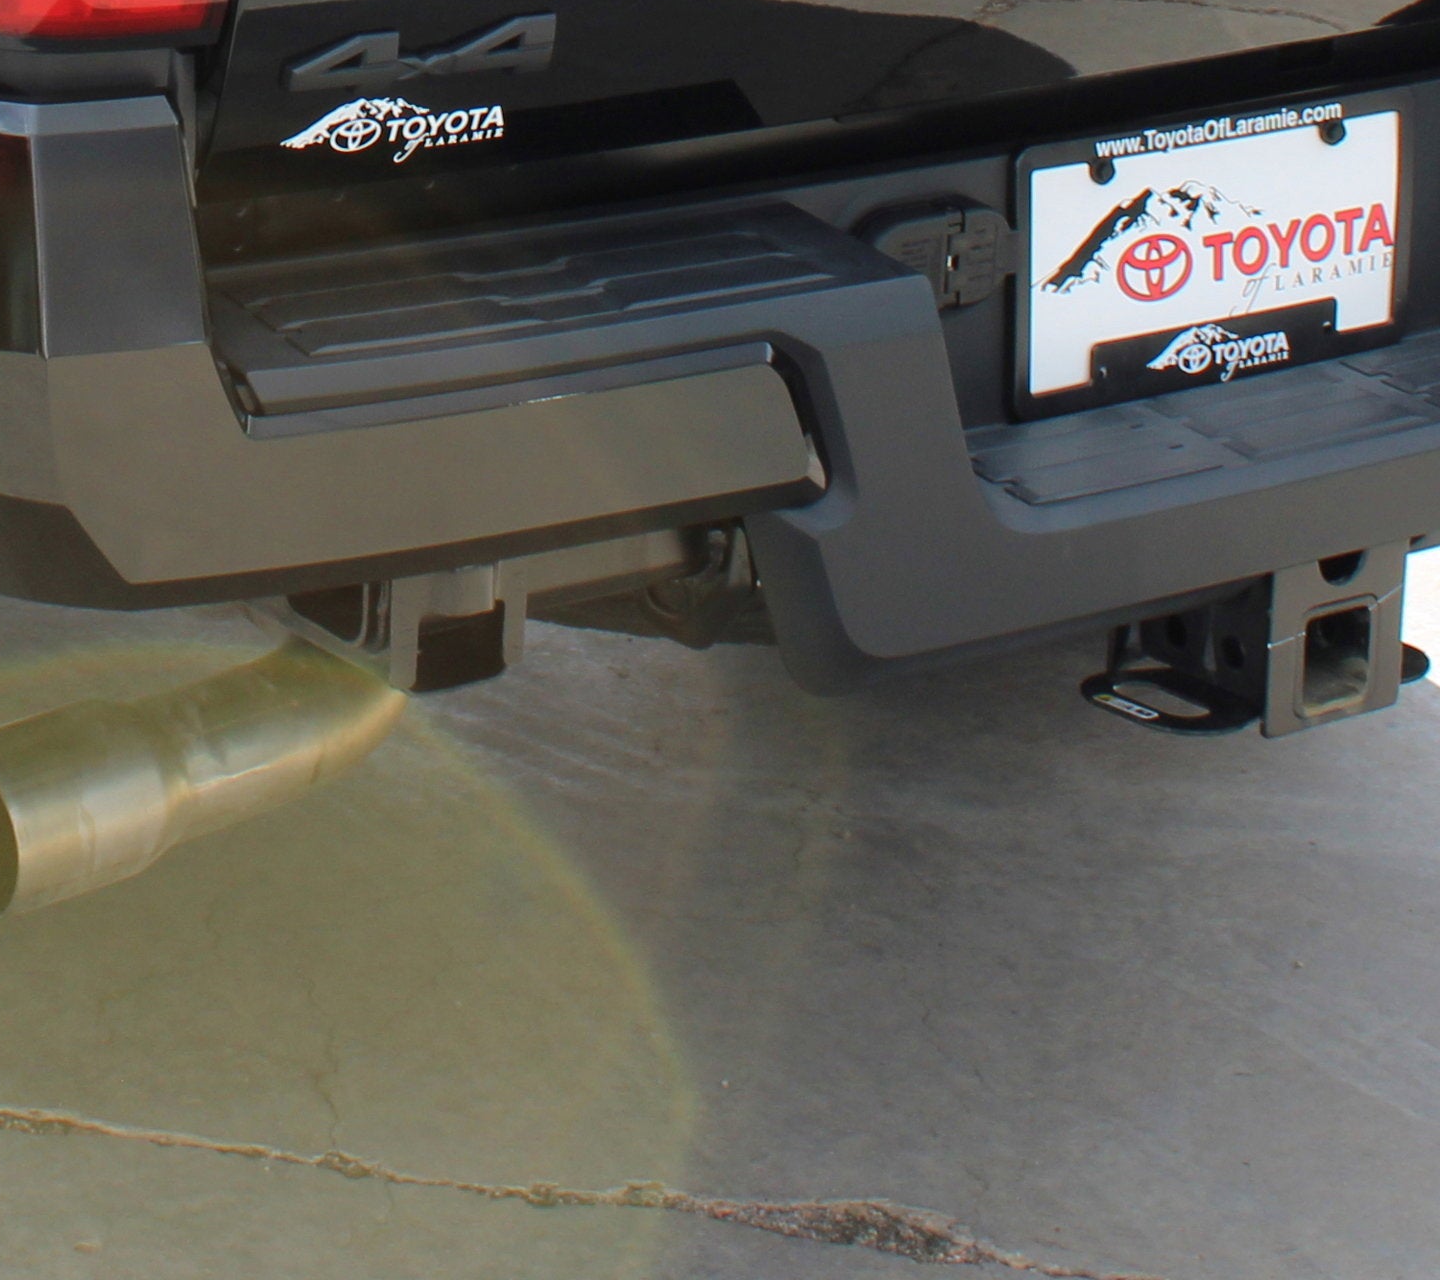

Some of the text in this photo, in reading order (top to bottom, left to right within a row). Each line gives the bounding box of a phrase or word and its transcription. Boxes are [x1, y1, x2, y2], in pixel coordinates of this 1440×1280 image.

[385, 104, 506, 144] TOYOTA
[424, 127, 506, 149] LARAMIE
[1094, 102, 1344, 159] www.ToyotaOfLaramie.com
[1201, 202, 1396, 282] TOYOTA
[1274, 253, 1395, 293] LARAMIE
[1212, 330, 1291, 365] TOYOTA
